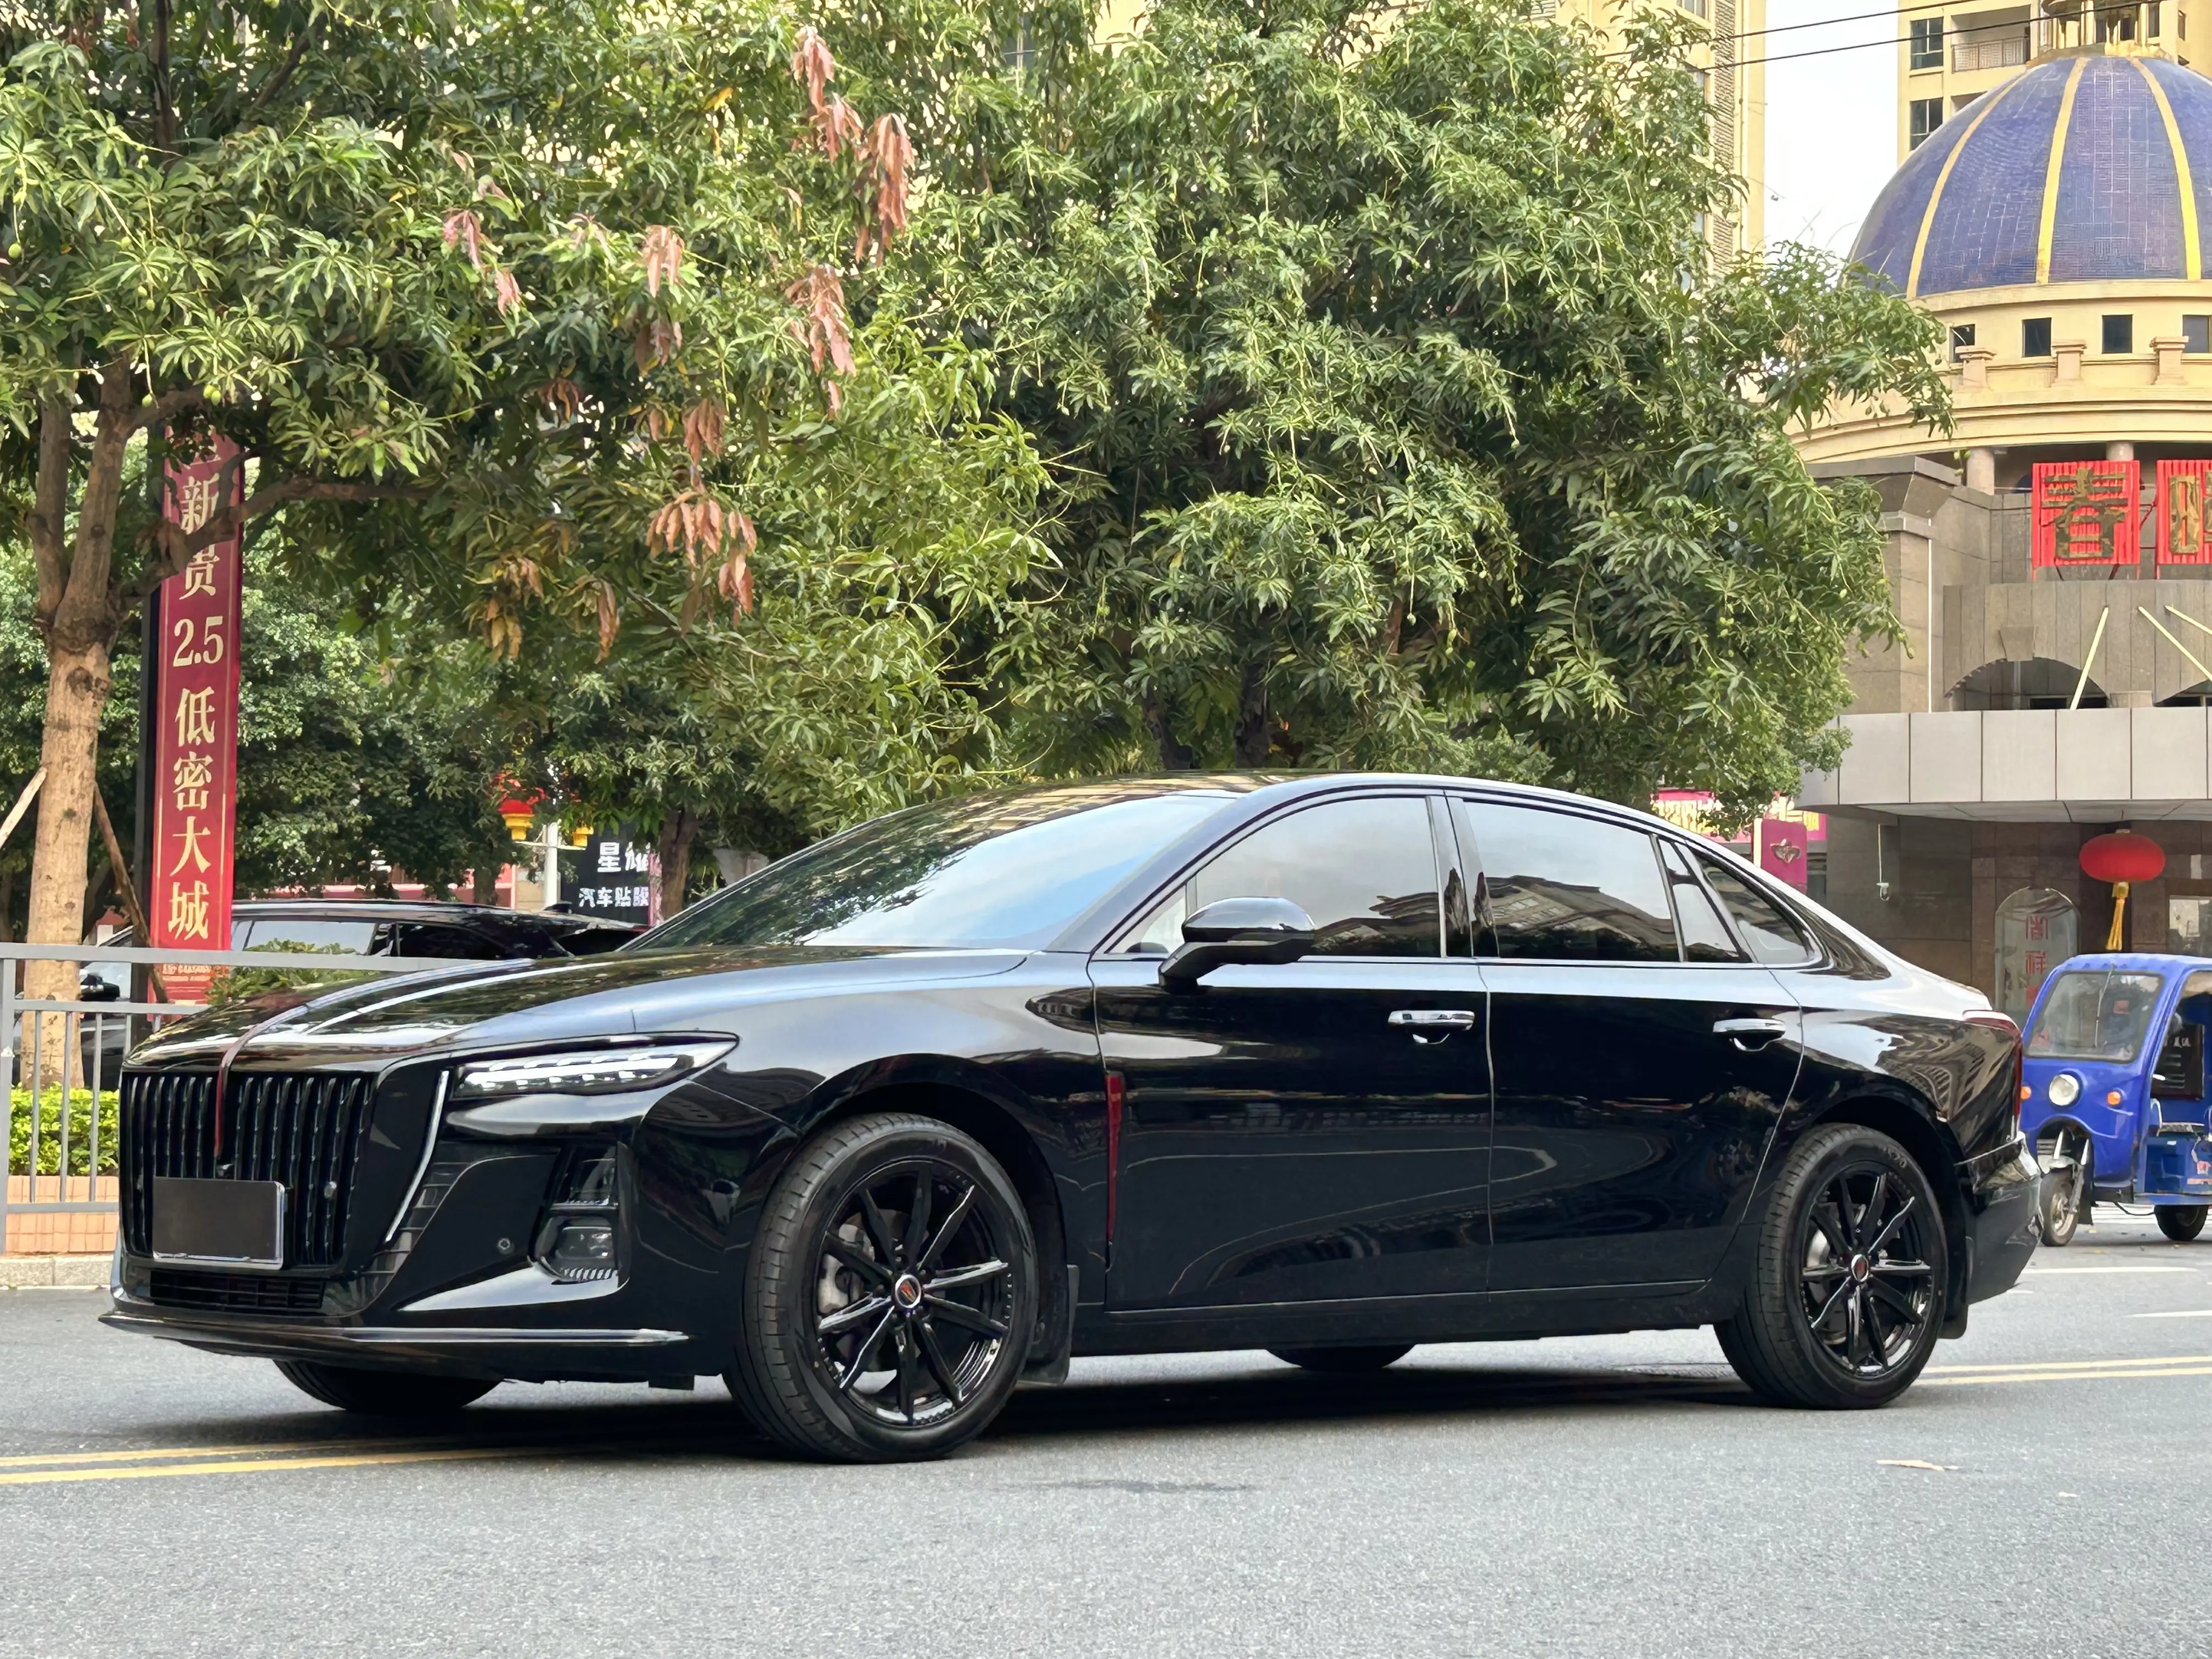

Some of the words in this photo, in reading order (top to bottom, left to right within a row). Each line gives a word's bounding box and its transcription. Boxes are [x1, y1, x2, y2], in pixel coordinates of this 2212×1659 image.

[168, 420, 224, 941] 新贵2.5低密大城
